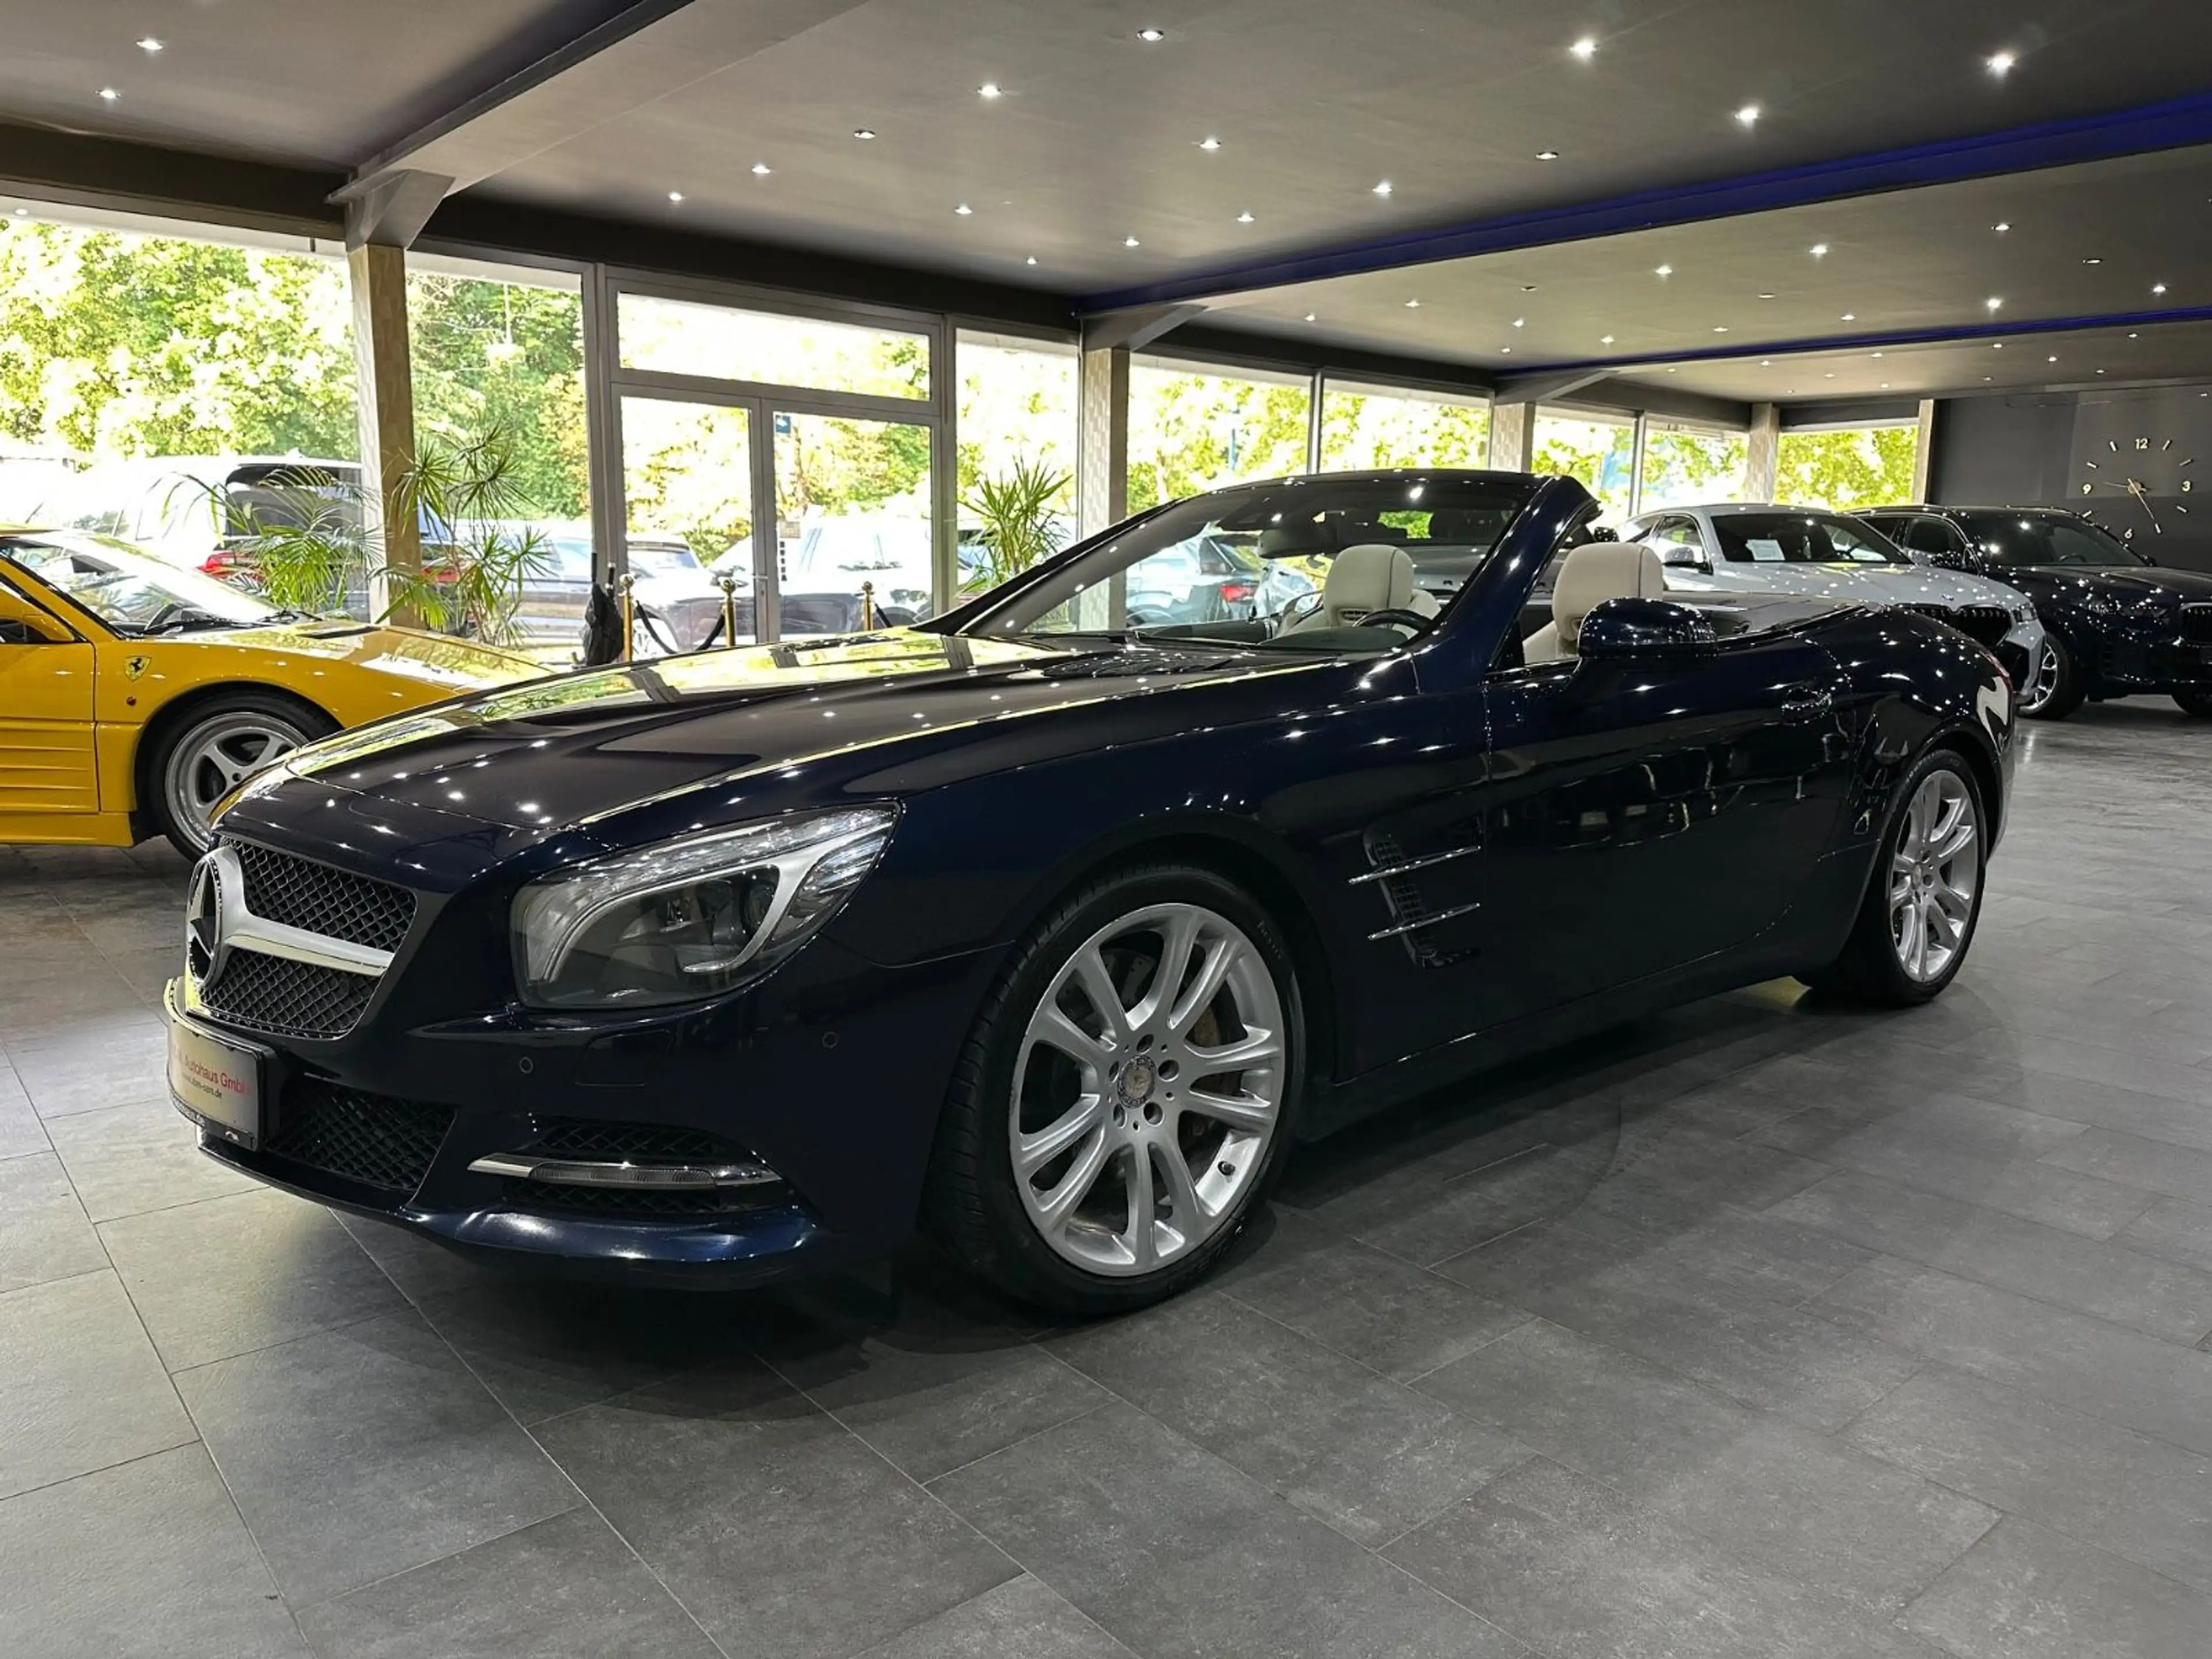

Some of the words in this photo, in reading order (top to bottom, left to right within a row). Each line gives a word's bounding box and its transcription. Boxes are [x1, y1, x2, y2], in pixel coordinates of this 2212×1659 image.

[2135, 438, 2149, 449] 12
[2082, 483, 2092, 494] 9
[2182, 481, 2191, 492] 3
[2124, 528, 2133, 539] 6
